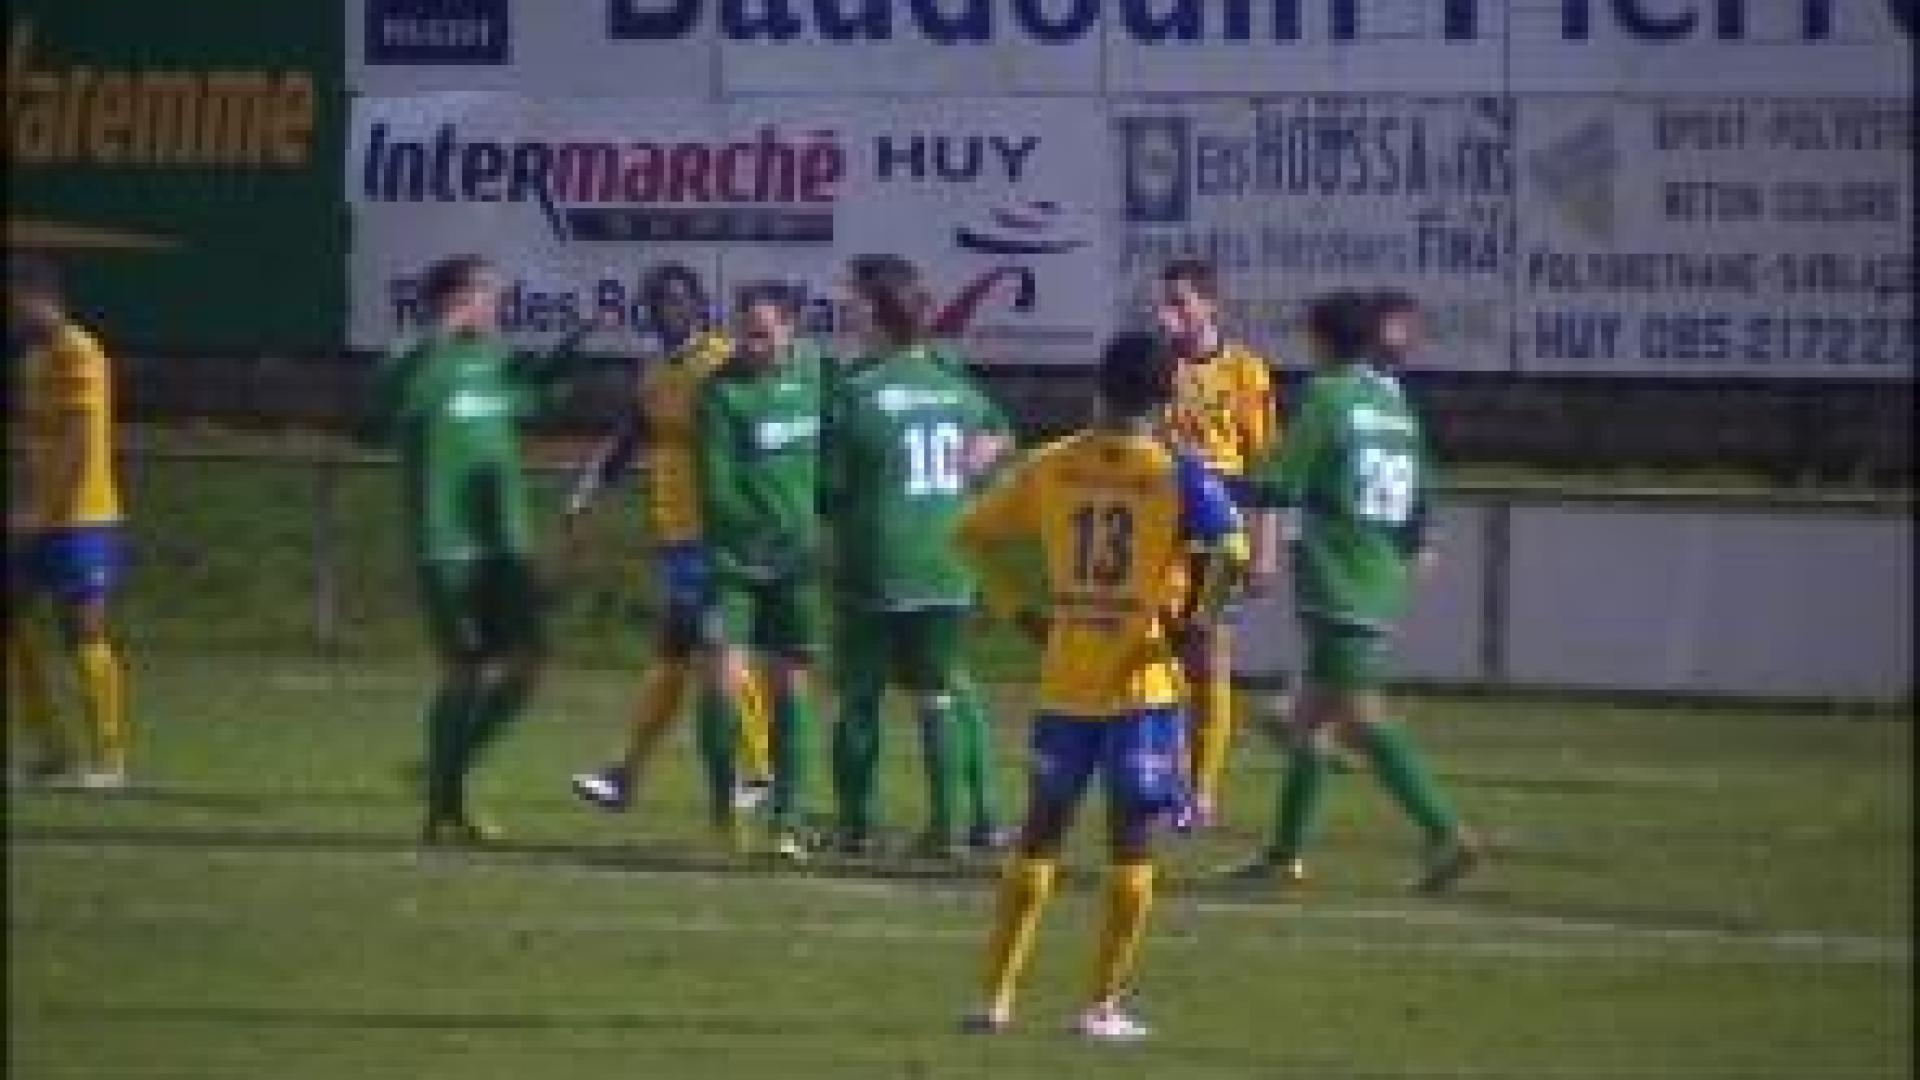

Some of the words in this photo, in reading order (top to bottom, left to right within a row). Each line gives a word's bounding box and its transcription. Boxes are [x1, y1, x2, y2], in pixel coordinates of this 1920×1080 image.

[8, 18, 314, 165] aremme
[874, 133, 1041, 183] HUY
[1534, 311, 1622, 359] HUY
[903, 421, 959, 496] 10
[1070, 505, 1134, 588] 13
